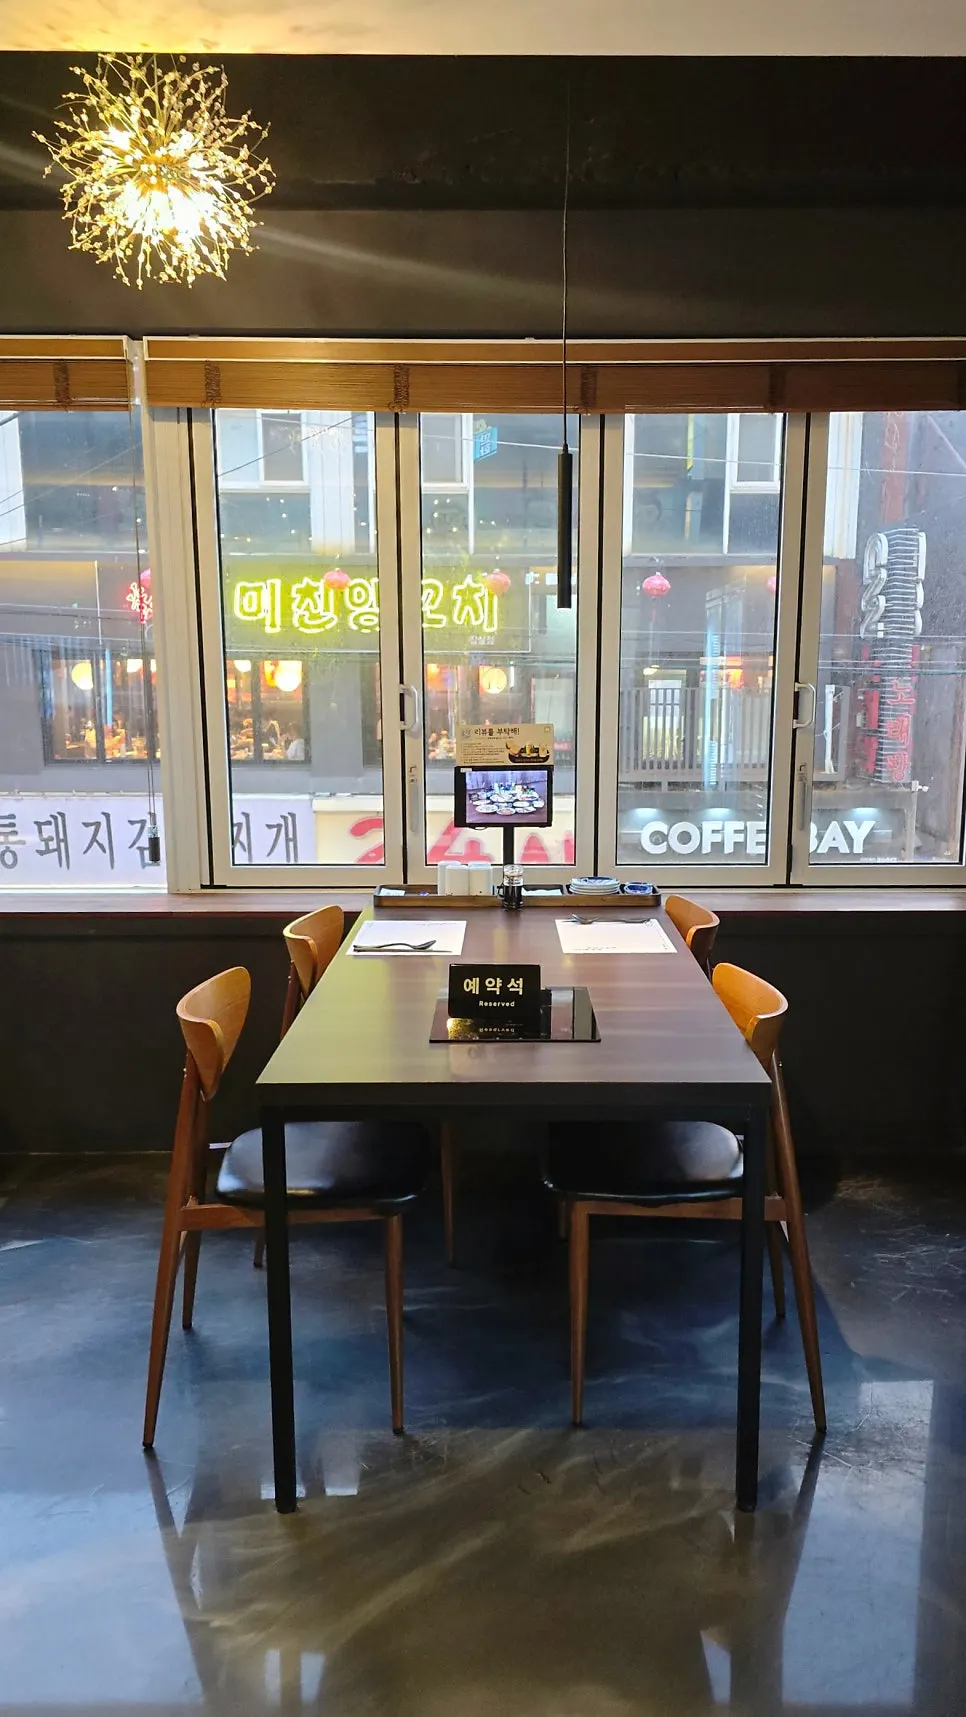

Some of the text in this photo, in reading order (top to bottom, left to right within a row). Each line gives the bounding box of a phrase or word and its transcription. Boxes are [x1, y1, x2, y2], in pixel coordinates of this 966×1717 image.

[474, 727, 520, 736] 리뷰를 부탁해!
[640, 820, 767, 855] COFFE
[463, 977, 524, 995] 예약석
